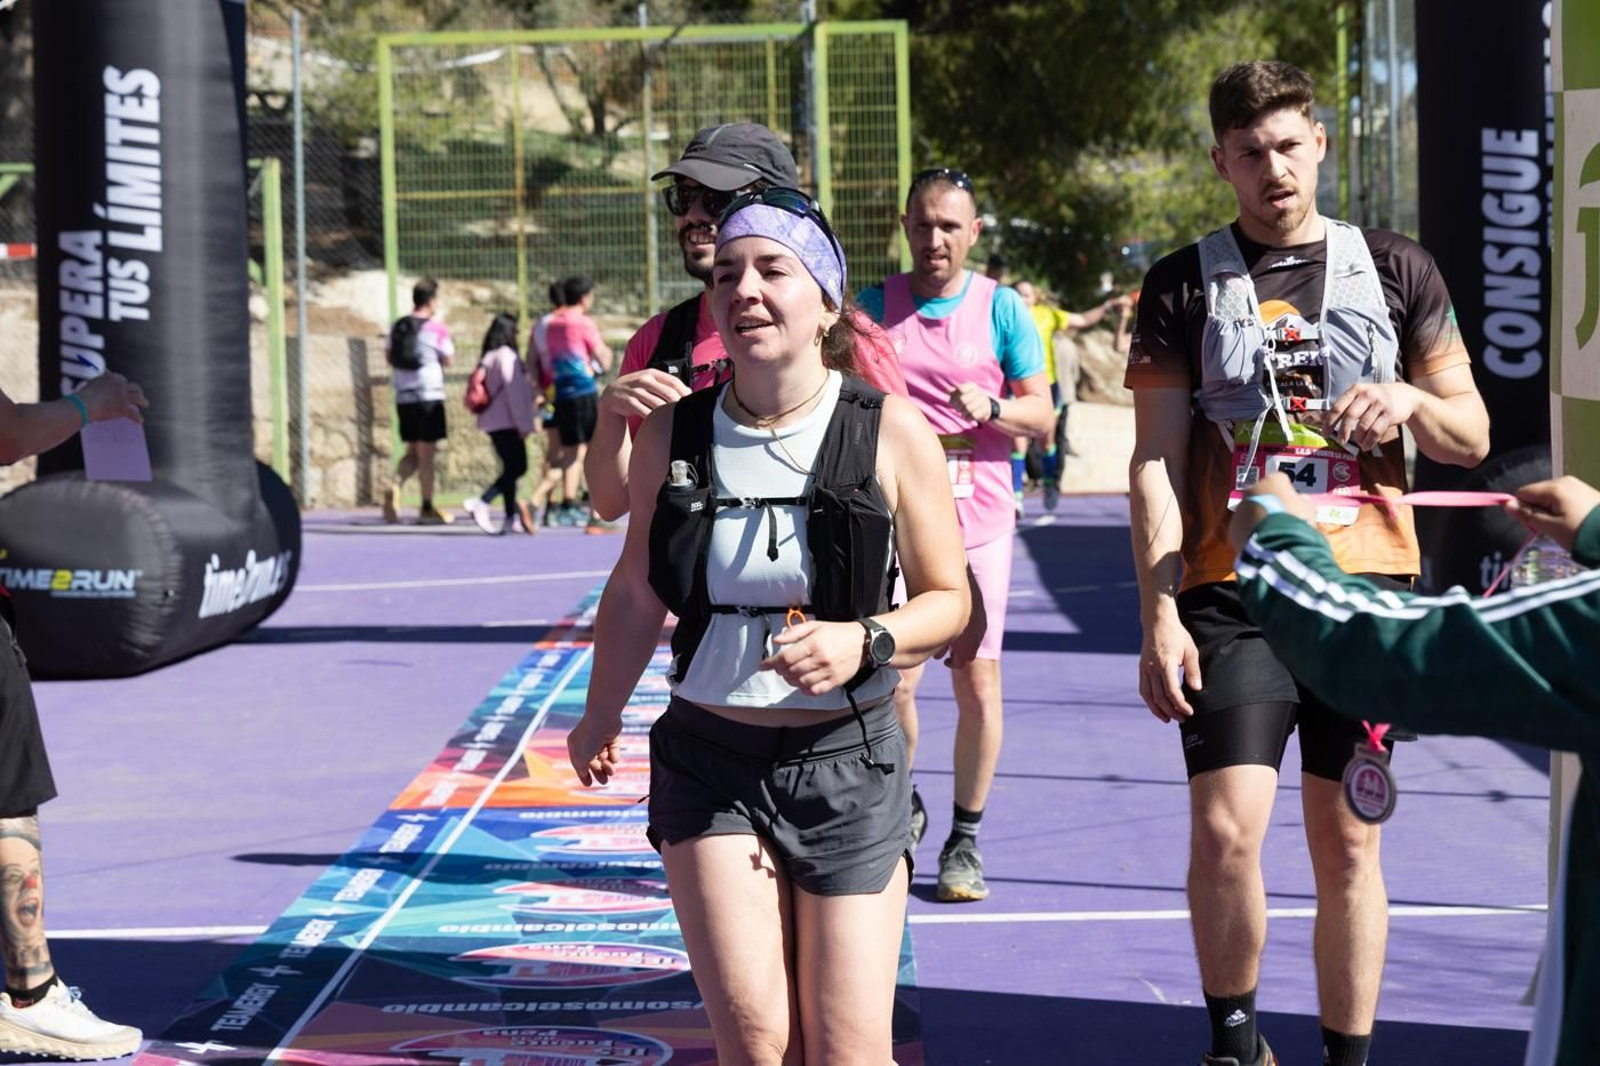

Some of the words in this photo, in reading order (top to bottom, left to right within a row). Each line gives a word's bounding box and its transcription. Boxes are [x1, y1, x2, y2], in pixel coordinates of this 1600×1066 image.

[93, 65, 163, 252] LÍMITES
[57, 229, 105, 396] SUPERA
[108, 257, 150, 321] TUS
[1481, 127, 1542, 379] CONSIGUE
